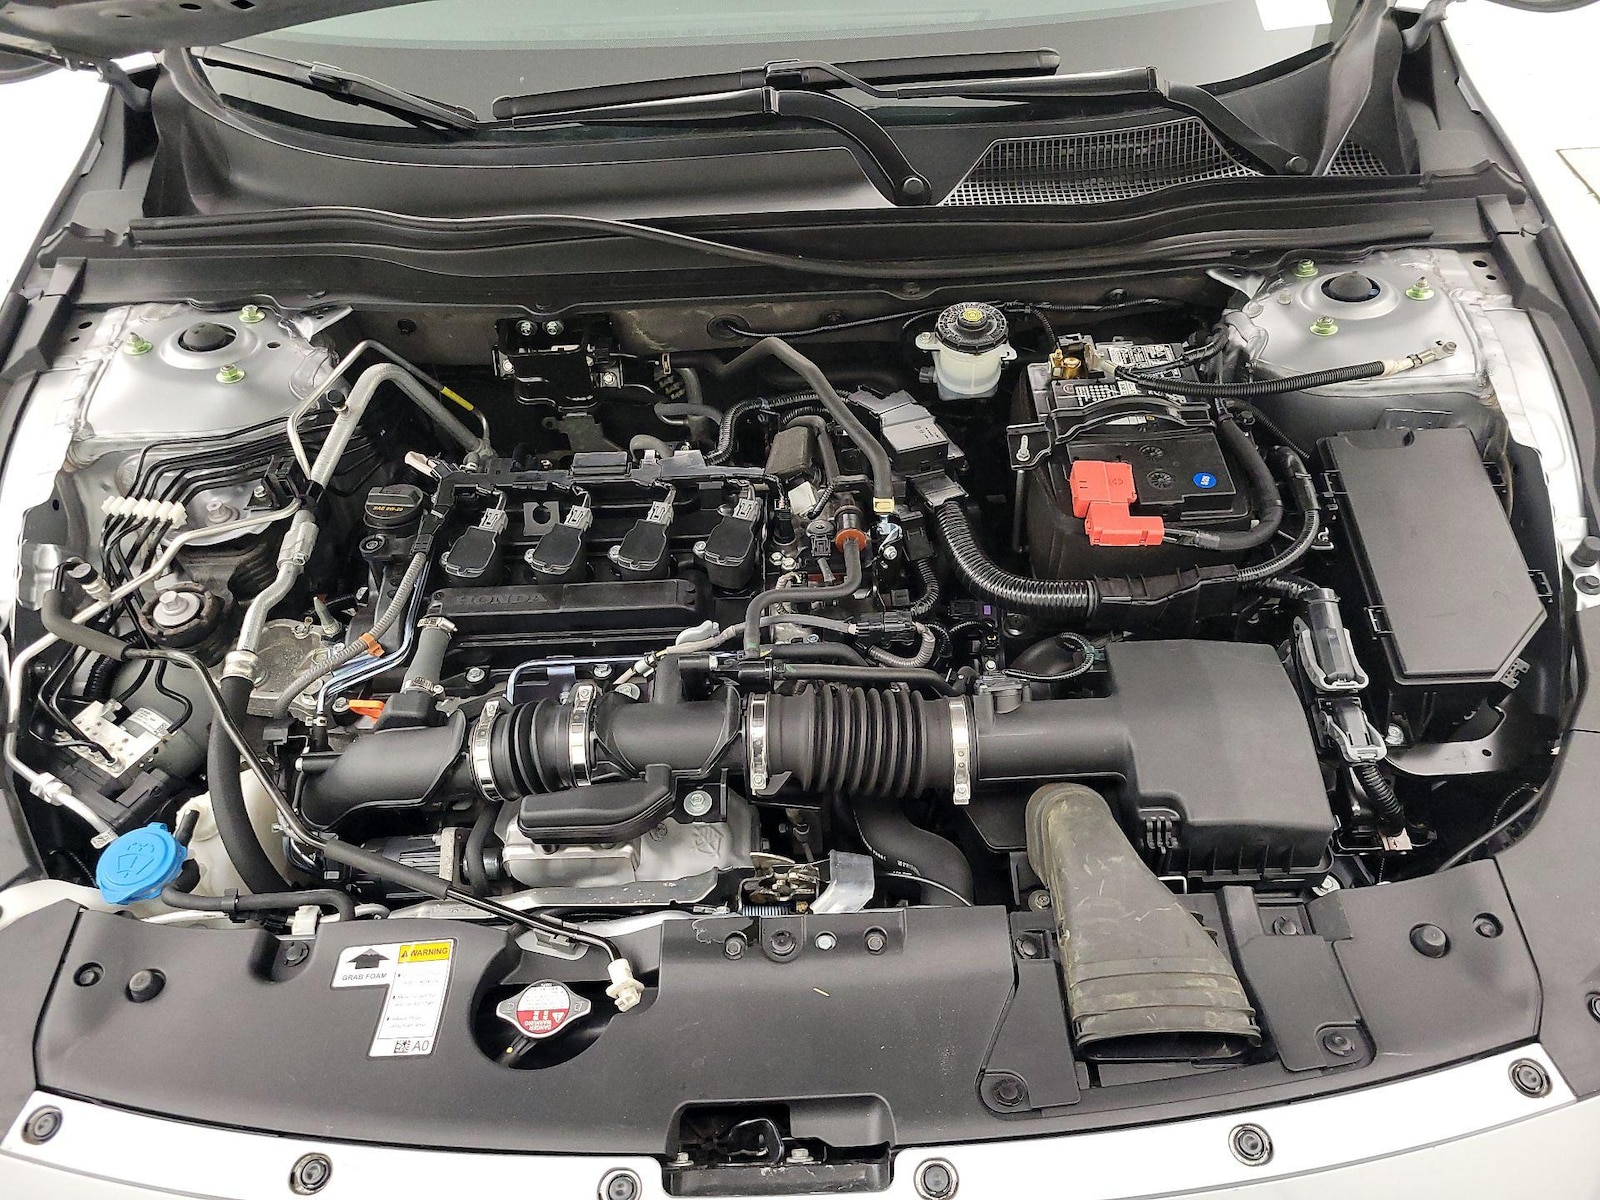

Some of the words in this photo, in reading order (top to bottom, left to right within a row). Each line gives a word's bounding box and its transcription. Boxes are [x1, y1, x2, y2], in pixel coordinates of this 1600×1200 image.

[456, 592, 549, 605] HONDA
[410, 947, 448, 957] WARNING
[366, 972, 387, 980] FOAM
